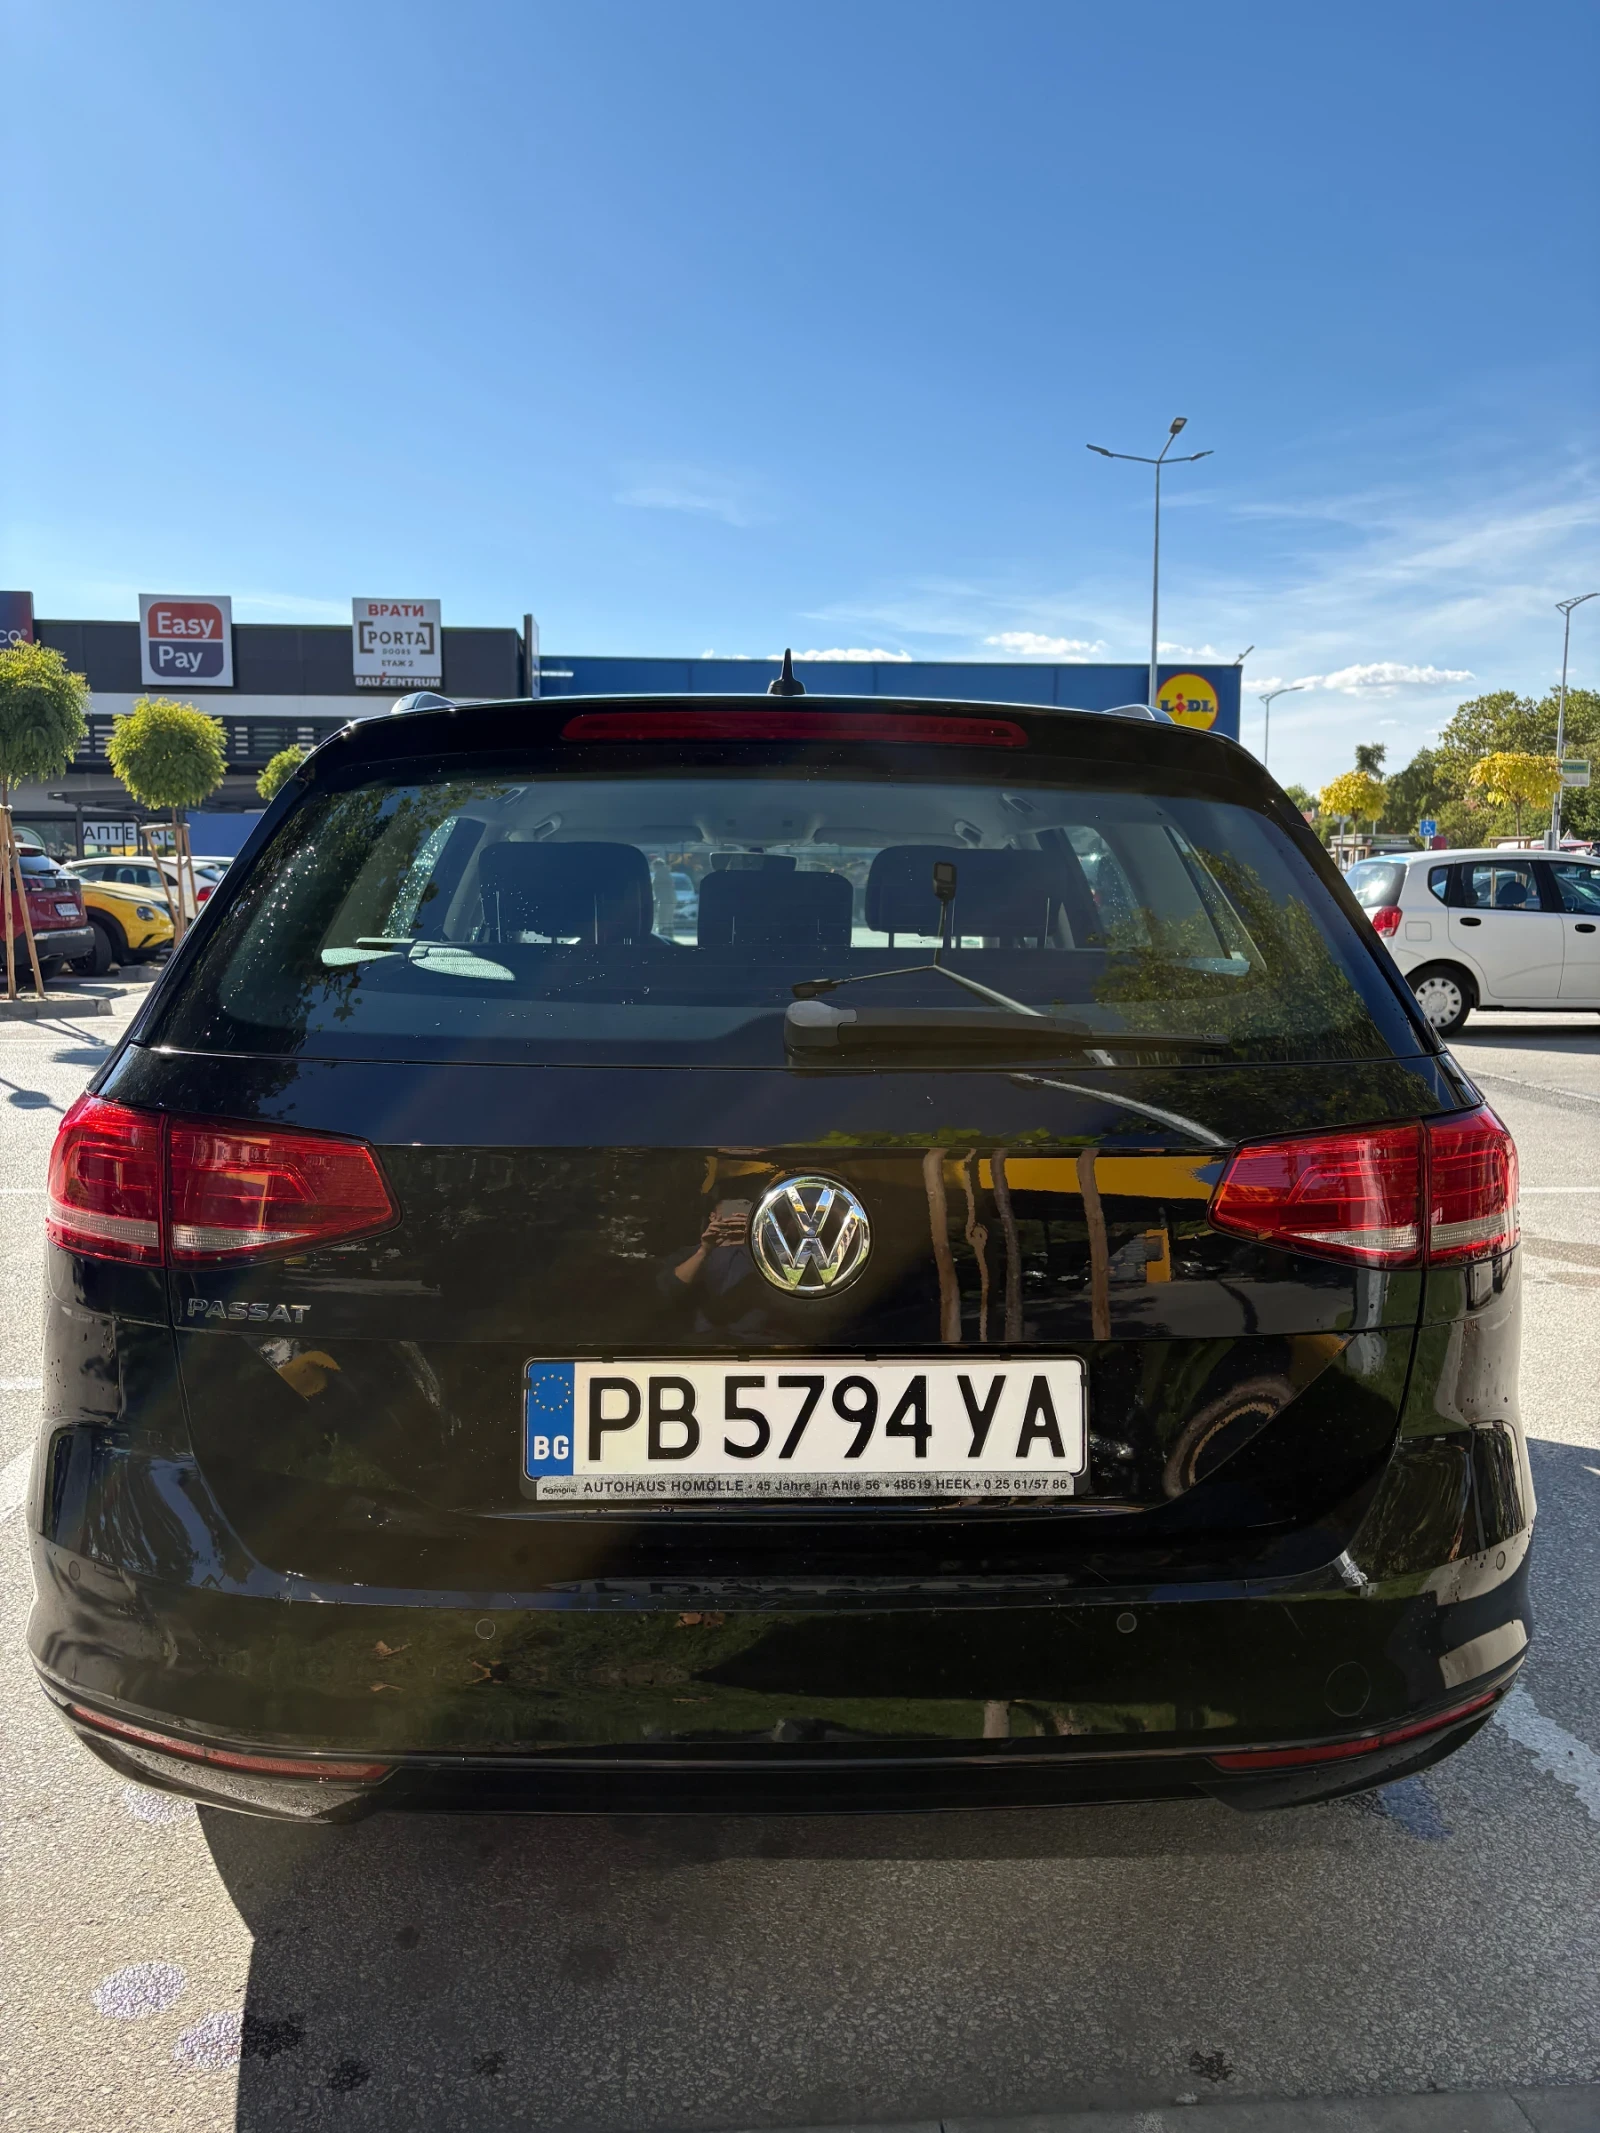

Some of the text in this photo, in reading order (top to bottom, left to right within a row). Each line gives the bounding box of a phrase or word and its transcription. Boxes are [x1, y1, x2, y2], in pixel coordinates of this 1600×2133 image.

[368, 604, 424, 617] ВРАТИ
[157, 611, 215, 639] Easy
[158, 645, 203, 673] Pay
[84, 826, 161, 840] АПТЕА
[187, 1298, 312, 1324] PASSAT
[588, 1375, 1065, 1461] PB 5794 YA
[533, 1435, 569, 1460] BG
[583, 1480, 666, 1493] AUTOHAUS
[670, 1478, 744, 1492] HOMÖLLE
[756, 1480, 771, 1491] 45
[774, 1479, 811, 1491] Jahre
[865, 1479, 880, 1490] 56
[893, 1478, 932, 1490] 48619
[936, 1478, 972, 1490] HEEK
[983, 1478, 992, 1490] 0
[994, 1478, 1010, 1490] 25
[1013, 1478, 1049, 1490] 61/57
[1052, 1478, 1068, 1490] 86
